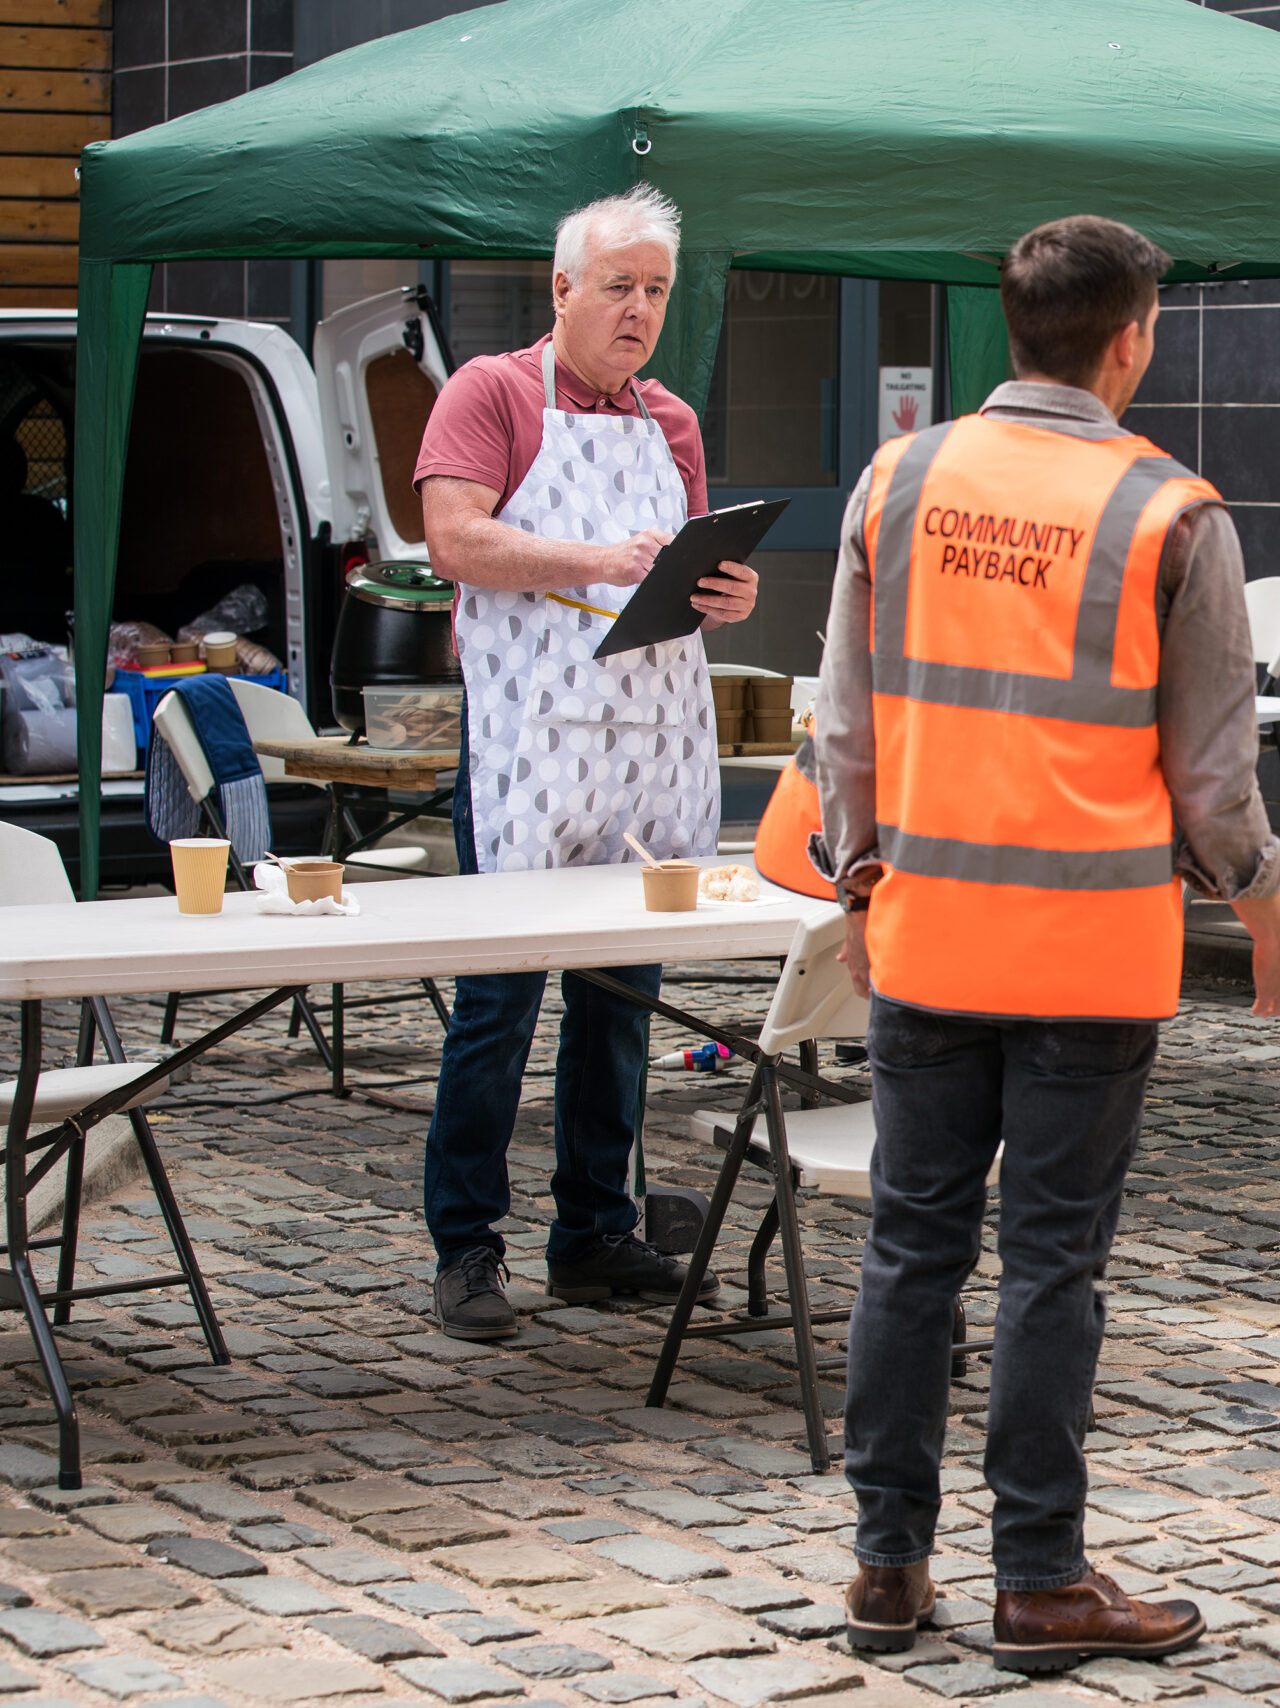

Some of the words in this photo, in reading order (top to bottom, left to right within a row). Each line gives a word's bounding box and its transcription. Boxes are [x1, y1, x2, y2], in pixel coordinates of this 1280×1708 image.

[885, 383, 927, 391] TAILGATING
[900, 372, 912, 380] NO
[925, 506, 1085, 558] COMMUNITY
[941, 545, 1052, 589] PAYBACK
